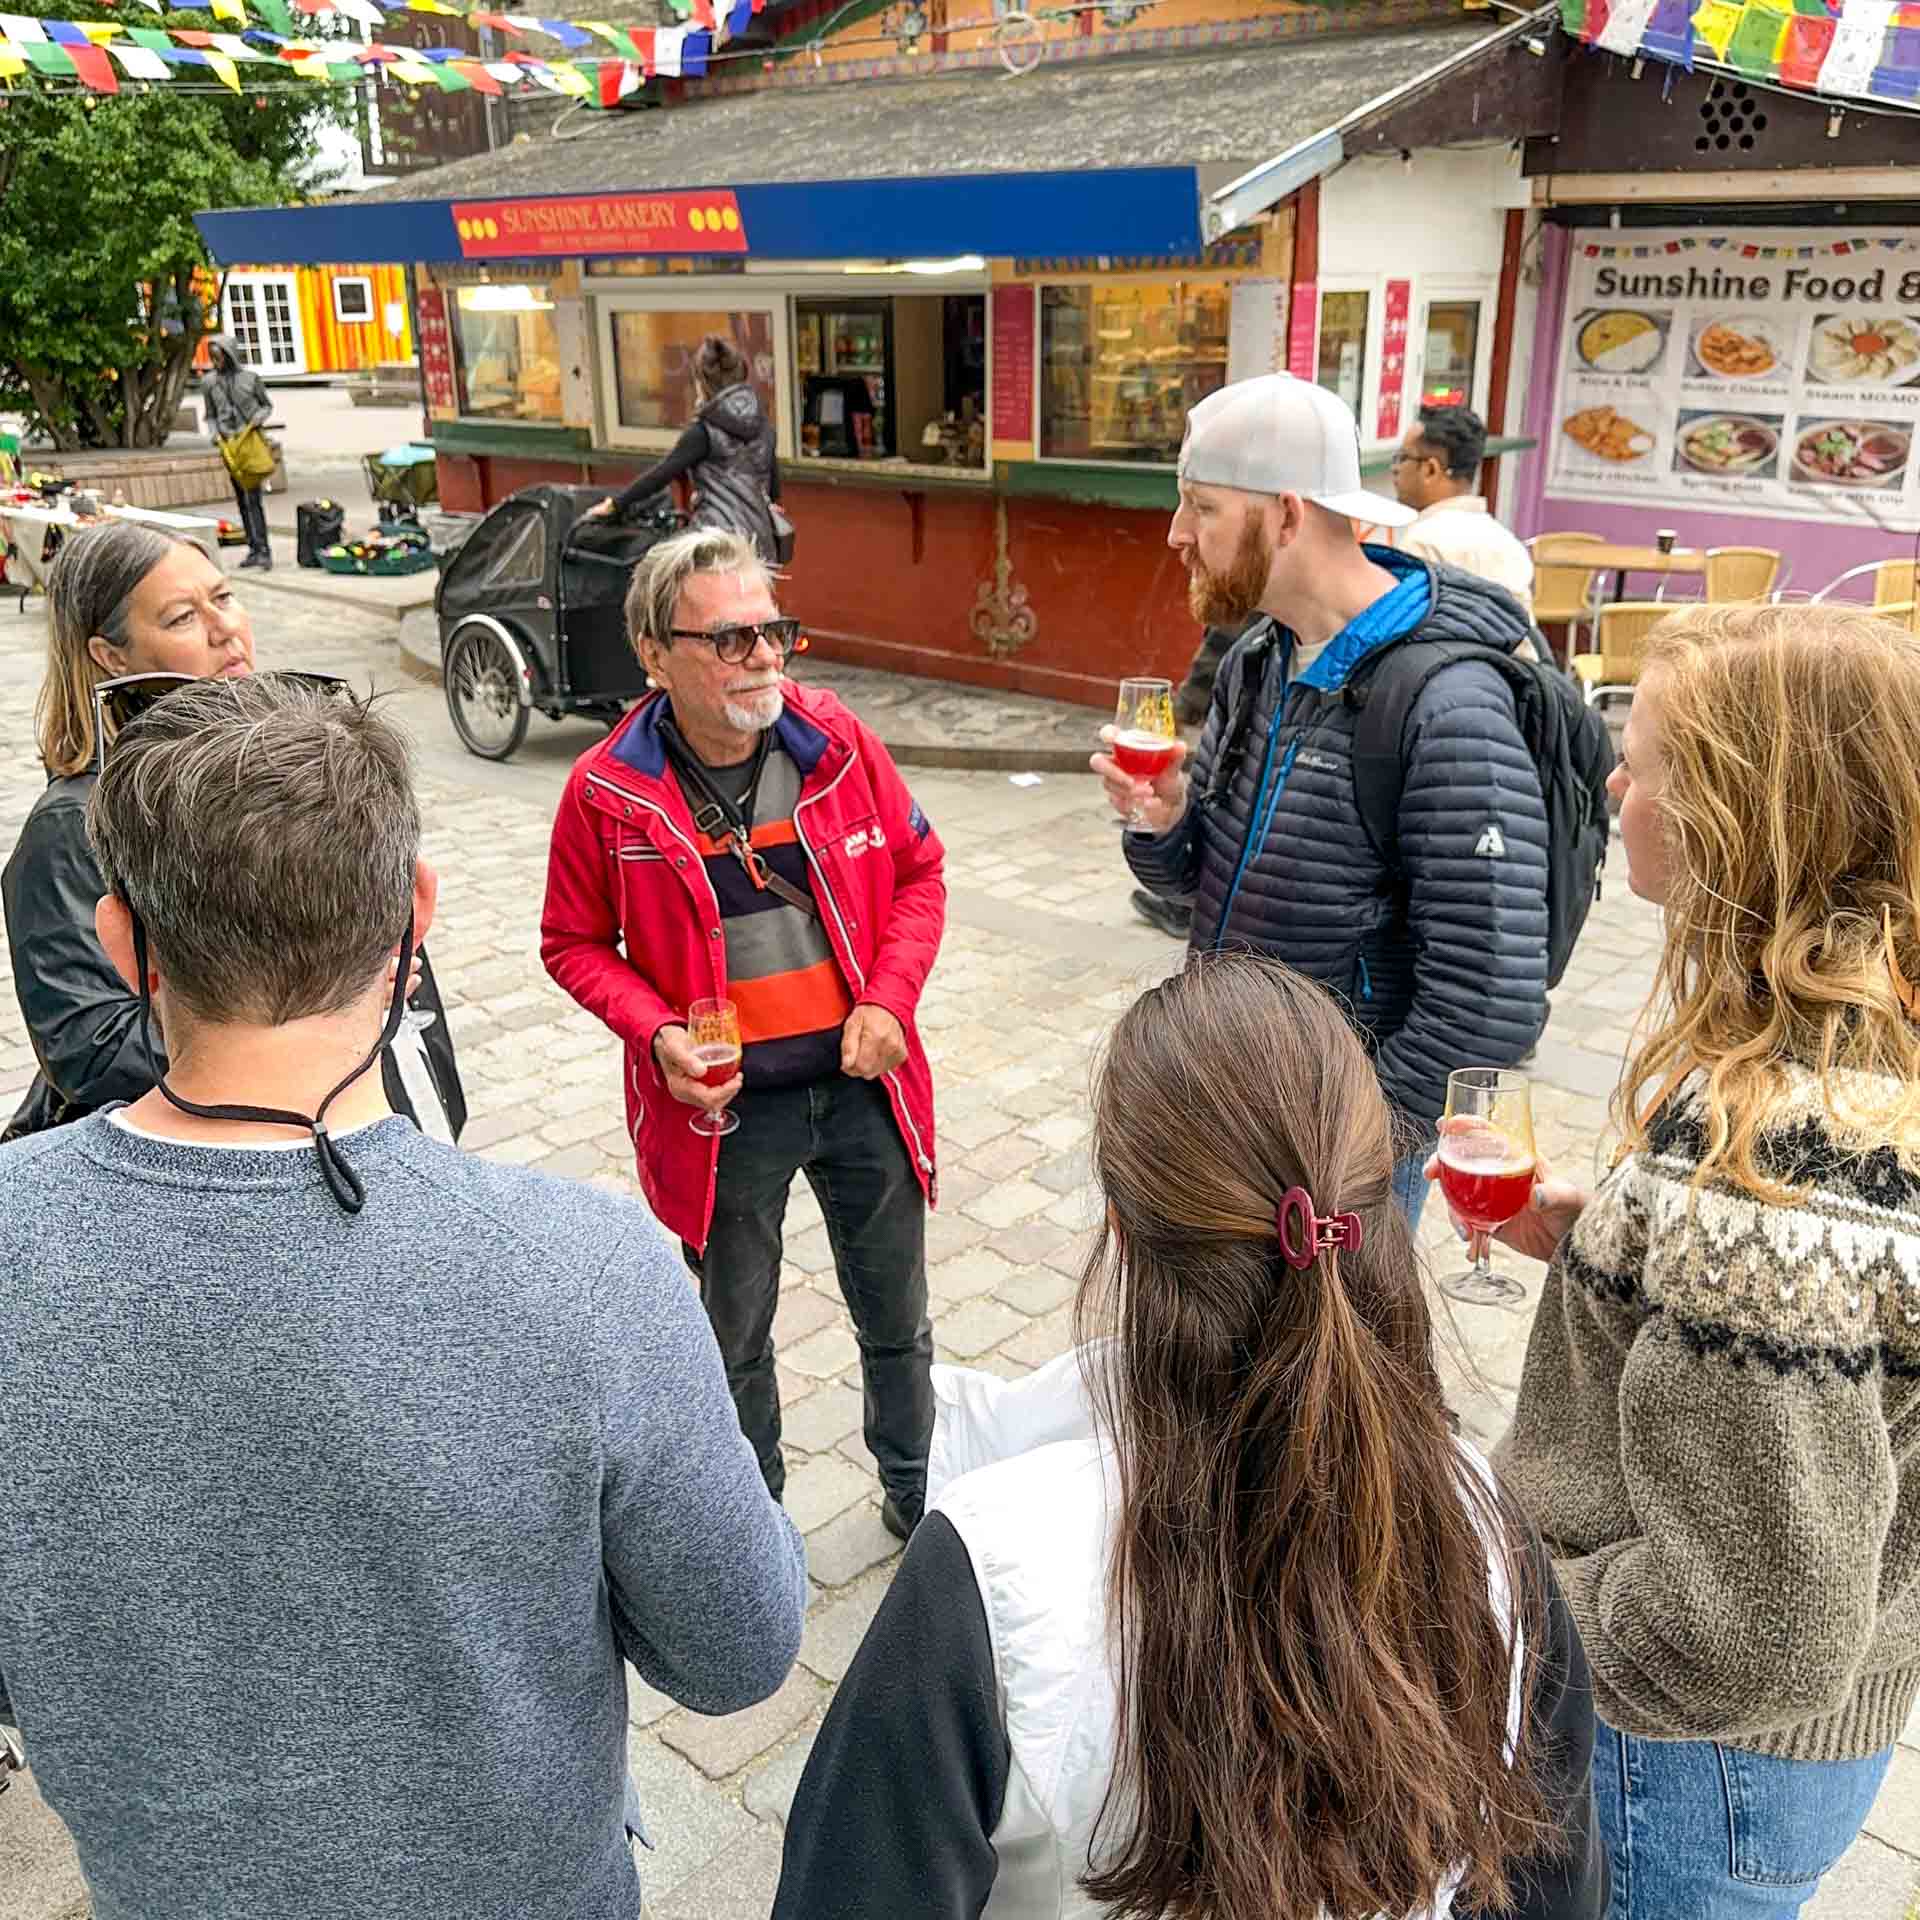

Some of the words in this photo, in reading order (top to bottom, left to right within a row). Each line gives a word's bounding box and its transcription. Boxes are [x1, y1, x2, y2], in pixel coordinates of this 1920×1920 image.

[502, 205, 596, 233] SUNSHINE
[597, 201, 675, 230] BAKERY
[1594, 266, 1771, 299] Sunshine
[1781, 267, 1886, 302] Food
